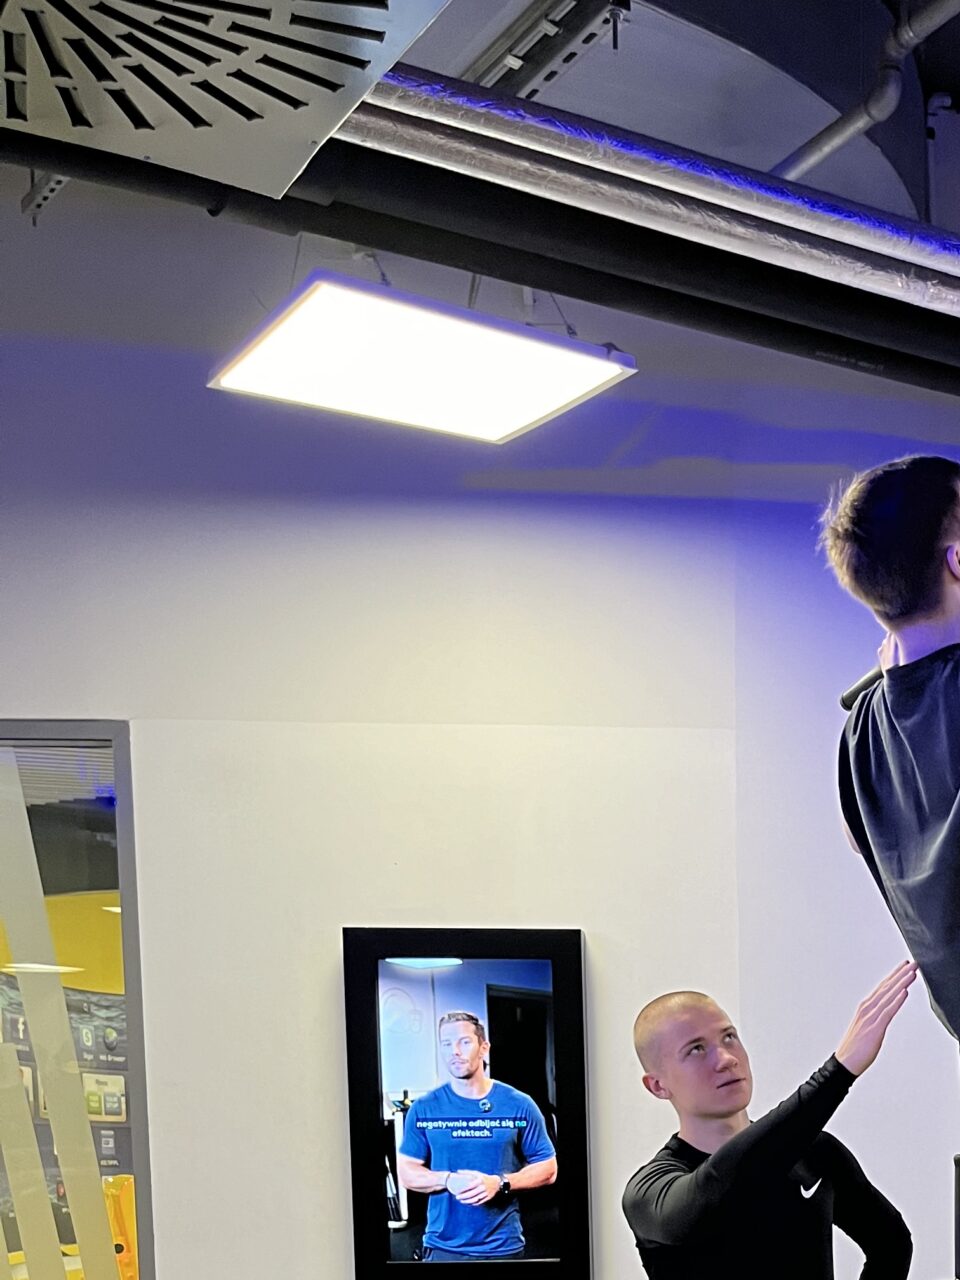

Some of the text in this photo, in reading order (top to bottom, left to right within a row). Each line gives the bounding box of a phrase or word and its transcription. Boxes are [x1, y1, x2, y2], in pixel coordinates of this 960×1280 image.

[416, 1120, 467, 1129] negatywnie
[469, 1119, 500, 1128] odbijać
[501, 1119, 514, 1129] się
[452, 1129, 493, 1137] efektach.
